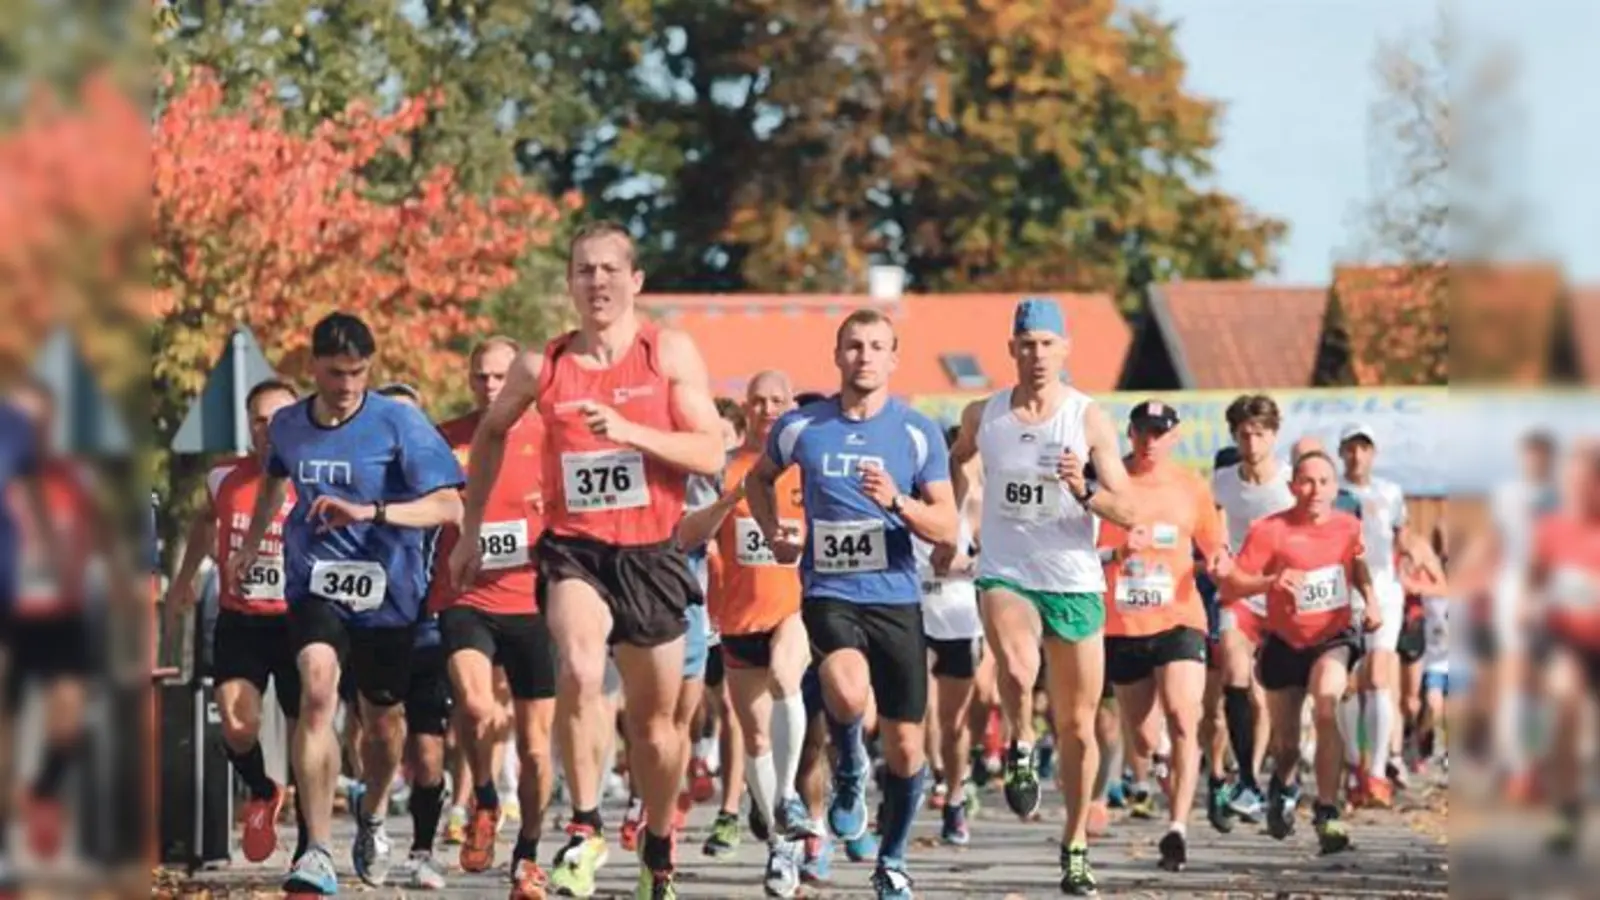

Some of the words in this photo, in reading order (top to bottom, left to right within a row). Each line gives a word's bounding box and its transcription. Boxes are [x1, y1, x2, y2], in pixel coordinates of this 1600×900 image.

[576, 466, 631, 495] 376
[1006, 482, 1044, 505] 691
[824, 534, 873, 558] 344
[323, 572, 373, 598] 340
[1303, 579, 1338, 601] 367
